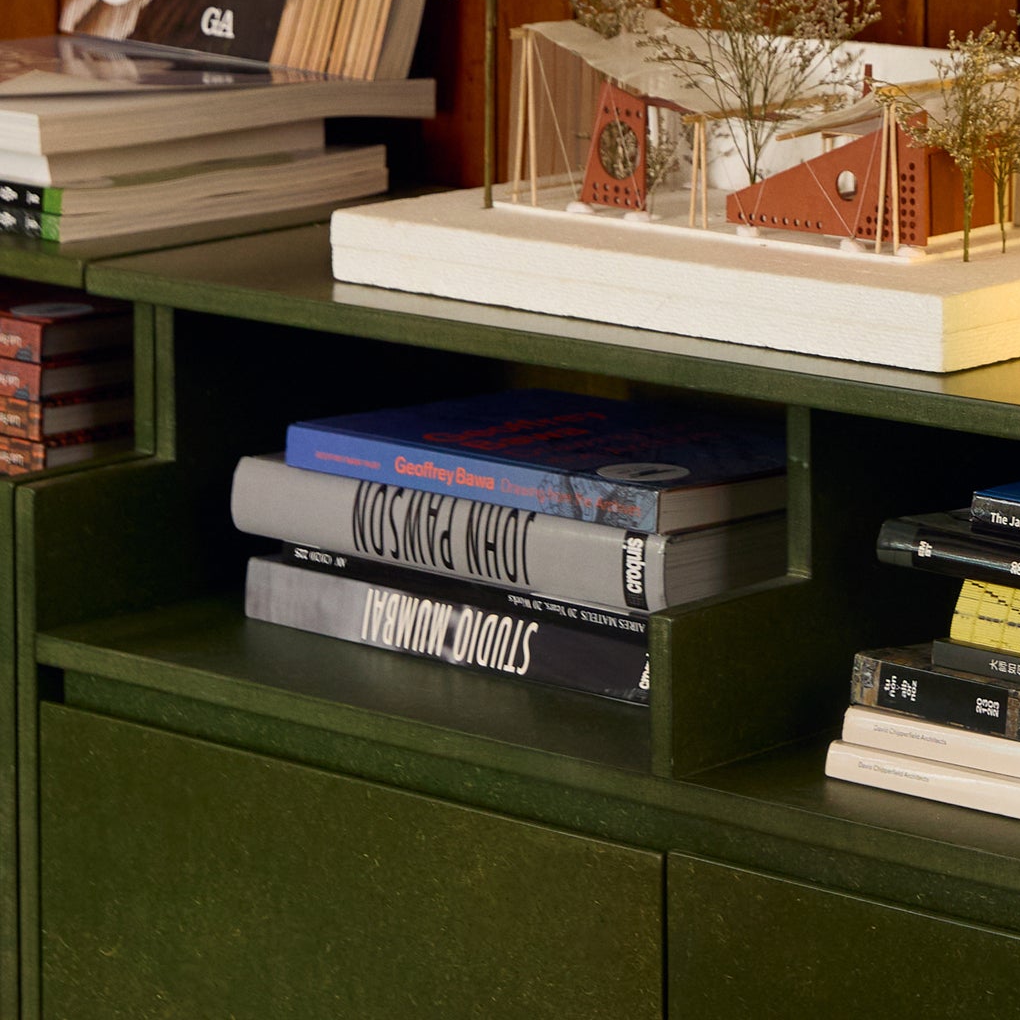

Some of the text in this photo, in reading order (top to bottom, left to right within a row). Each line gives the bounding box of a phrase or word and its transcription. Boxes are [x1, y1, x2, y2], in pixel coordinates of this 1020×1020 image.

[201, 7, 235, 38] GA
[394, 456, 454, 485] Geoffrey
[456, 467, 495, 490] Bawa
[501, 478, 545, 504] Drawing
[353, 480, 537, 585] JOHN PAWSON
[990, 512, 1008, 525] The
[622, 537, 646, 594] croquis
[361, 588, 539, 675] STUDIO MUMBAI
[580, 610, 618, 627] MATEUS
[619, 619, 646, 633] AIRES
[873, 765, 904, 778] Chipperfield
